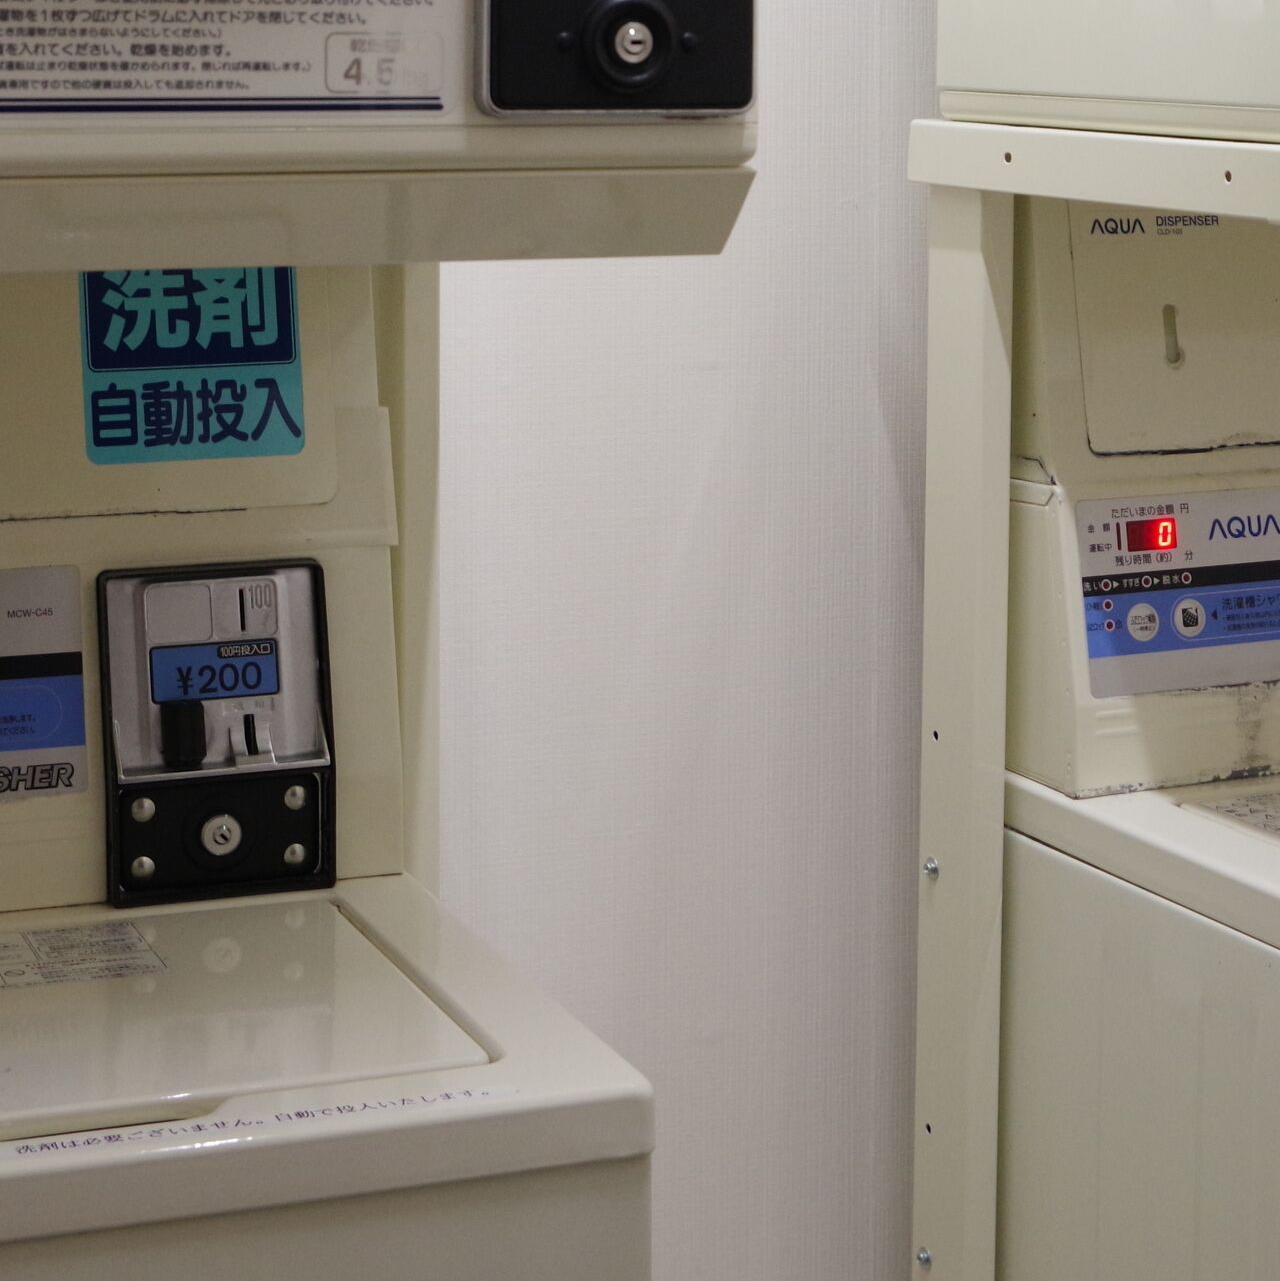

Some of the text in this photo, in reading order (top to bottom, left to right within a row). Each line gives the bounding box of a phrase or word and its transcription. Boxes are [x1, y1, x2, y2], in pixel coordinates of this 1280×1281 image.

[1091, 215, 1219, 234] AQUA DISPENSER
[101, 267, 279, 352] 洗剤
[91, 378, 302, 447] 自動投入
[1112, 503, 1190, 518] ただいまの金額 円
[1158, 522, 1172, 546] 0
[1209, 515, 1280, 540] AQUA
[1185, 550, 1193, 560] 分
[176, 662, 262, 695] ¥200
